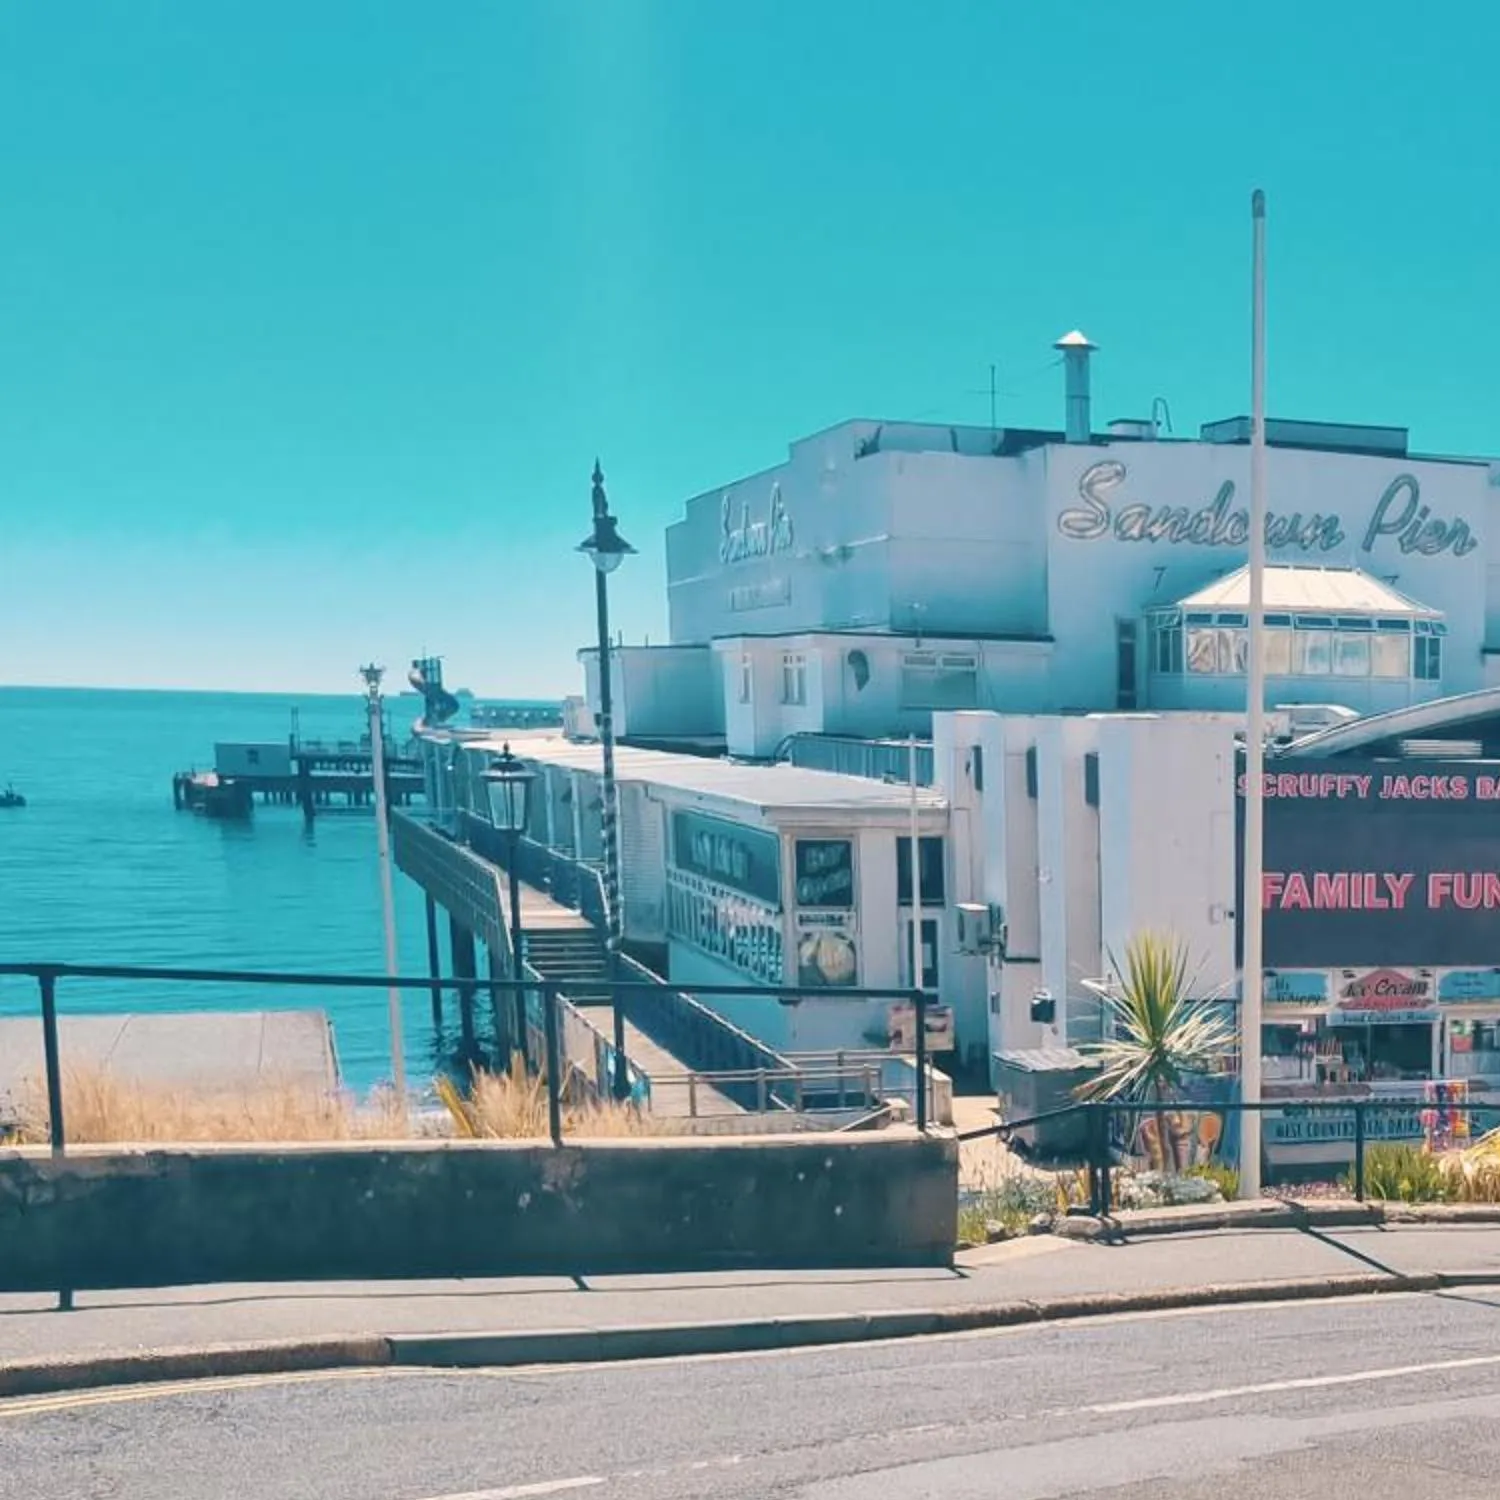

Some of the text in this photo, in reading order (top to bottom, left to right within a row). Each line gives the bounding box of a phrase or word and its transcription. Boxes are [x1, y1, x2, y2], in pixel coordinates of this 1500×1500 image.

[1058, 459, 1478, 557] Sandown Pier
[1379, 775, 1468, 800] JACKS
[1261, 872, 1415, 910] FAMILY
